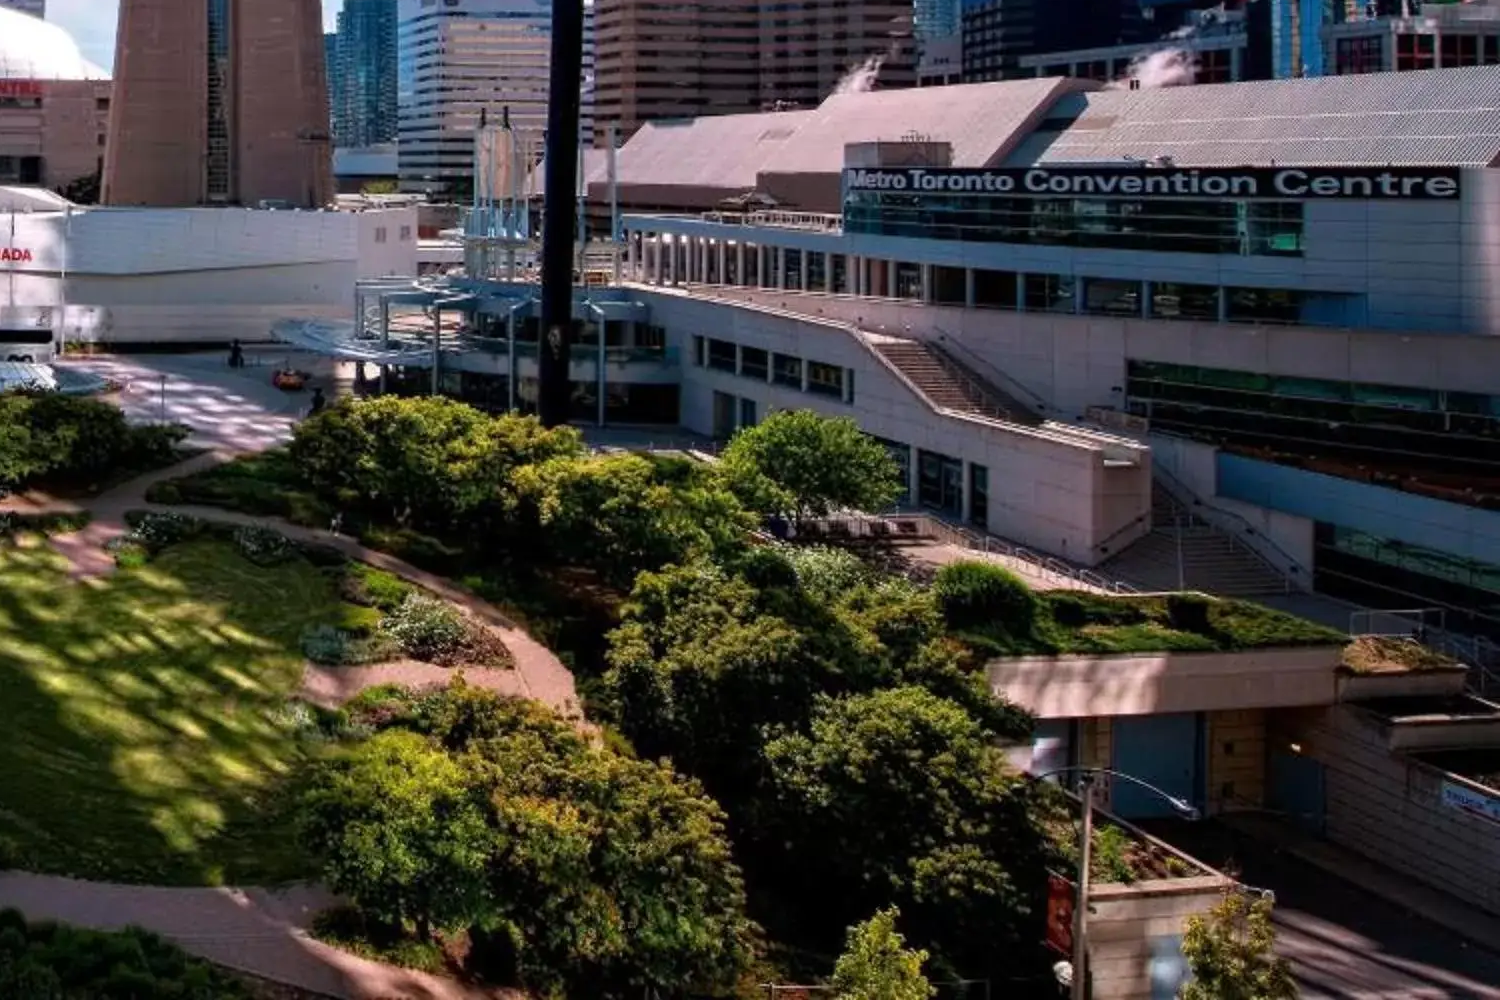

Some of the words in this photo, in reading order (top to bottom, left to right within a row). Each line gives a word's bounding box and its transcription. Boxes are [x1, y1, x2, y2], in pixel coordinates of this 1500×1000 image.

[847, 169, 907, 190] Metro
[908, 169, 1015, 192] Toronto
[1023, 169, 1258, 194] Convention
[1273, 169, 1458, 195] Centre
